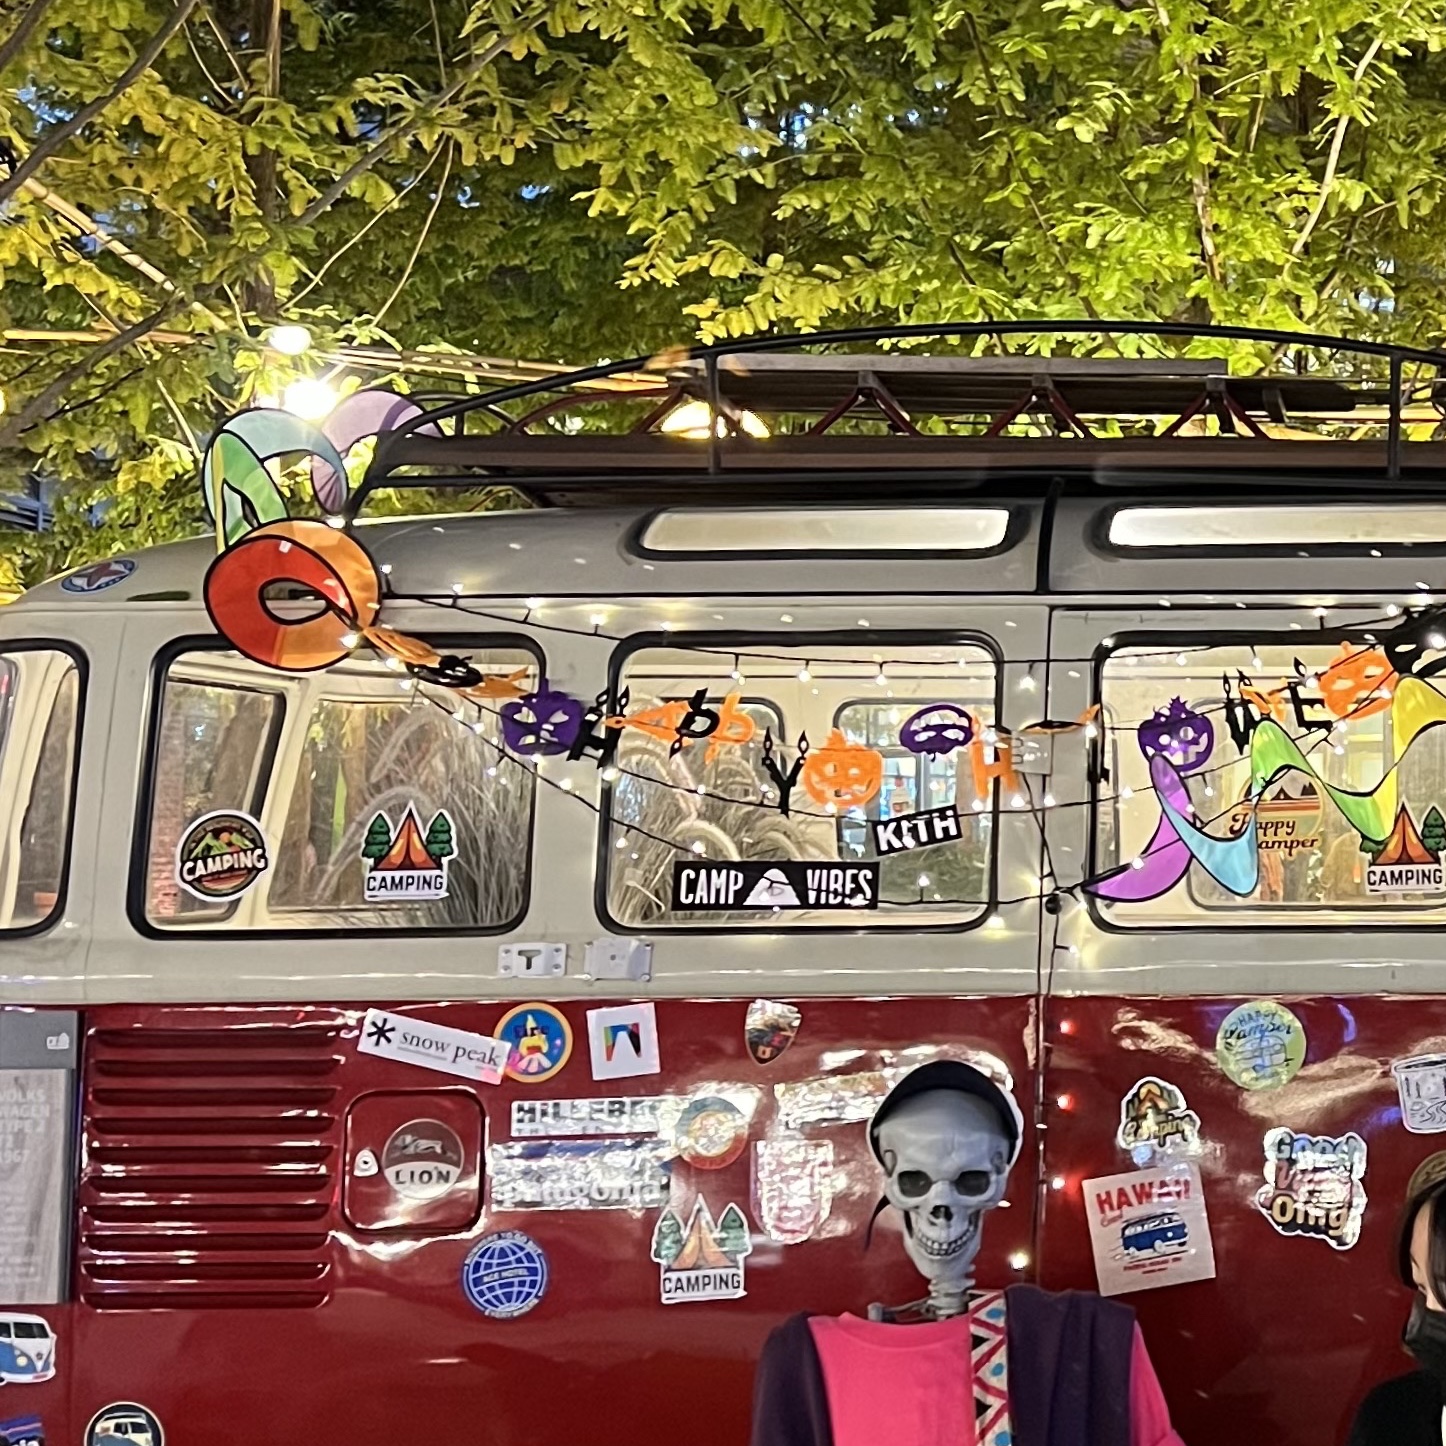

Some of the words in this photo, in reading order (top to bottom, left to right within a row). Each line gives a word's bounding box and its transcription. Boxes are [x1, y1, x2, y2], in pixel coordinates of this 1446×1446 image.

[181, 848, 266, 882] CAMPING
[367, 874, 444, 892] CAMPING
[679, 867, 744, 906] CAMP
[805, 867, 873, 907] VIBES
[1367, 867, 1443, 888] CAMPING
[399, 1028, 450, 1054] snow
[452, 1041, 500, 1068] peak
[394, 1168, 450, 1185] LION
[662, 1272, 741, 1294] CAMPING
